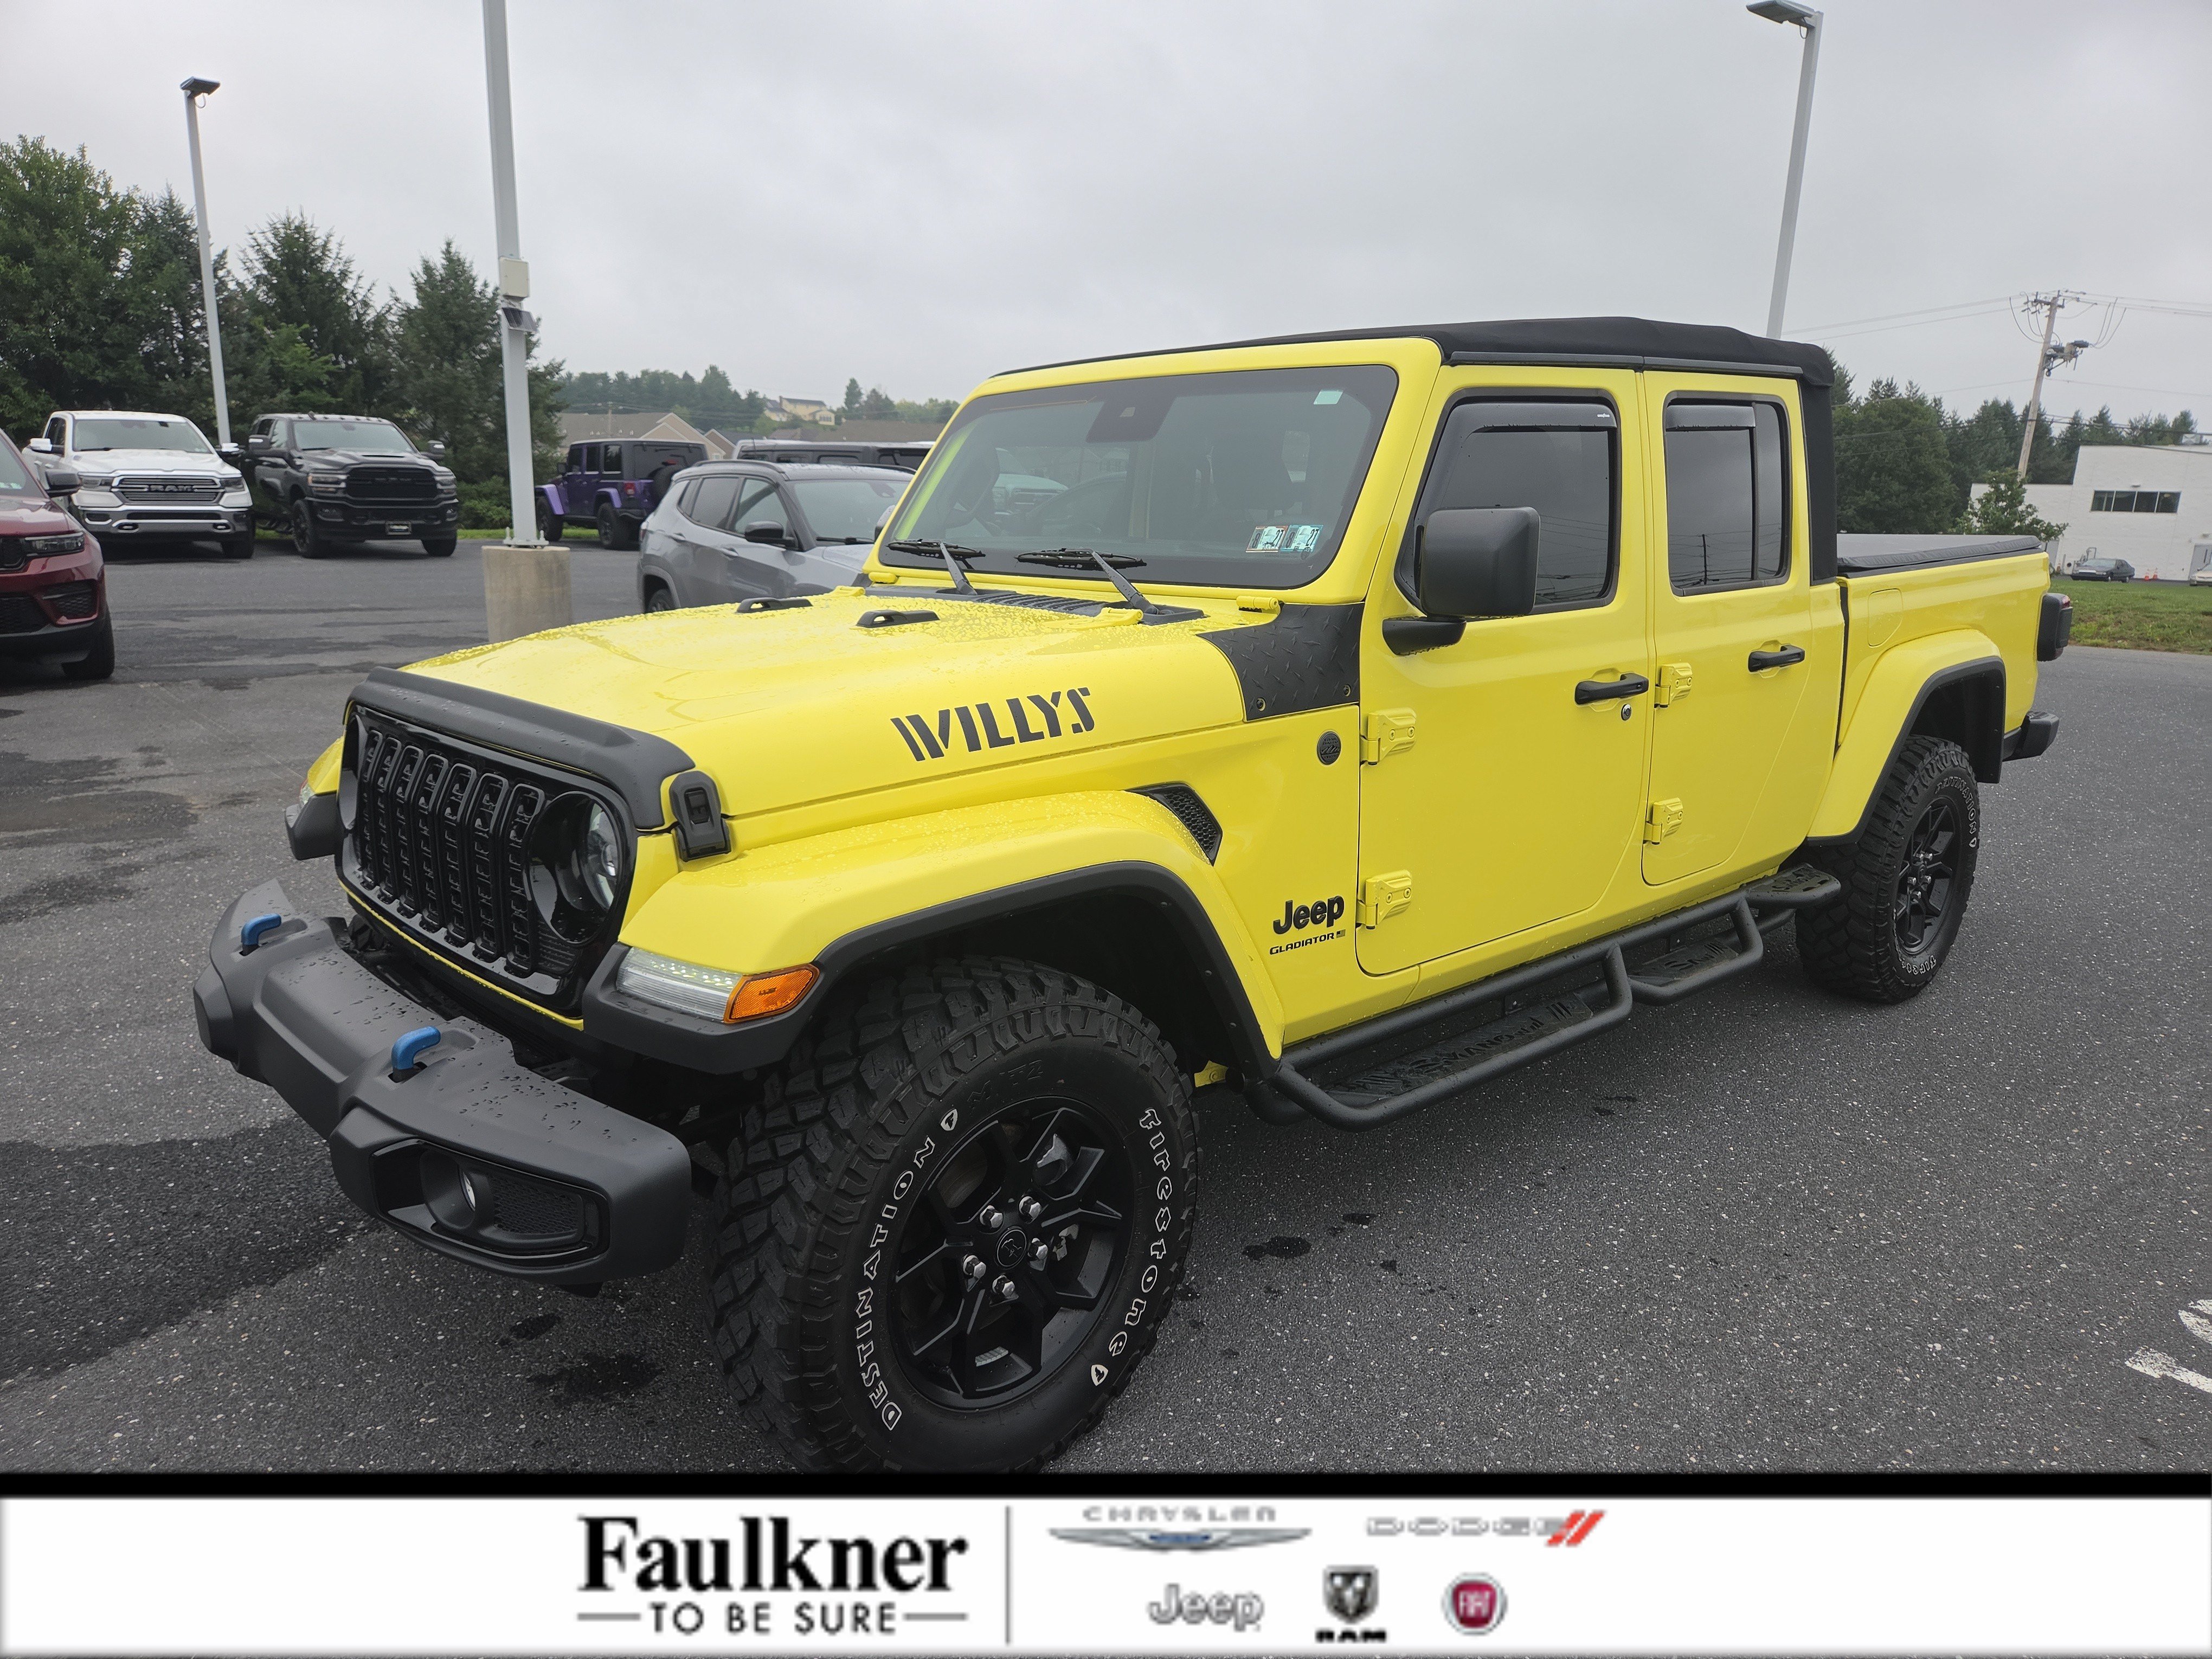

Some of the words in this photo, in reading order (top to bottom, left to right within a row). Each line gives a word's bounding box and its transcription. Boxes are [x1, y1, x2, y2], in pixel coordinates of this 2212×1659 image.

[1306, 529, 1319, 546] 27
[890, 687, 1095, 762] WILLYS
[1273, 896, 1345, 934] Jeep
[1270, 932, 1335, 955] GLADIATOR
[856, 1136, 936, 1431] DESTINATION
